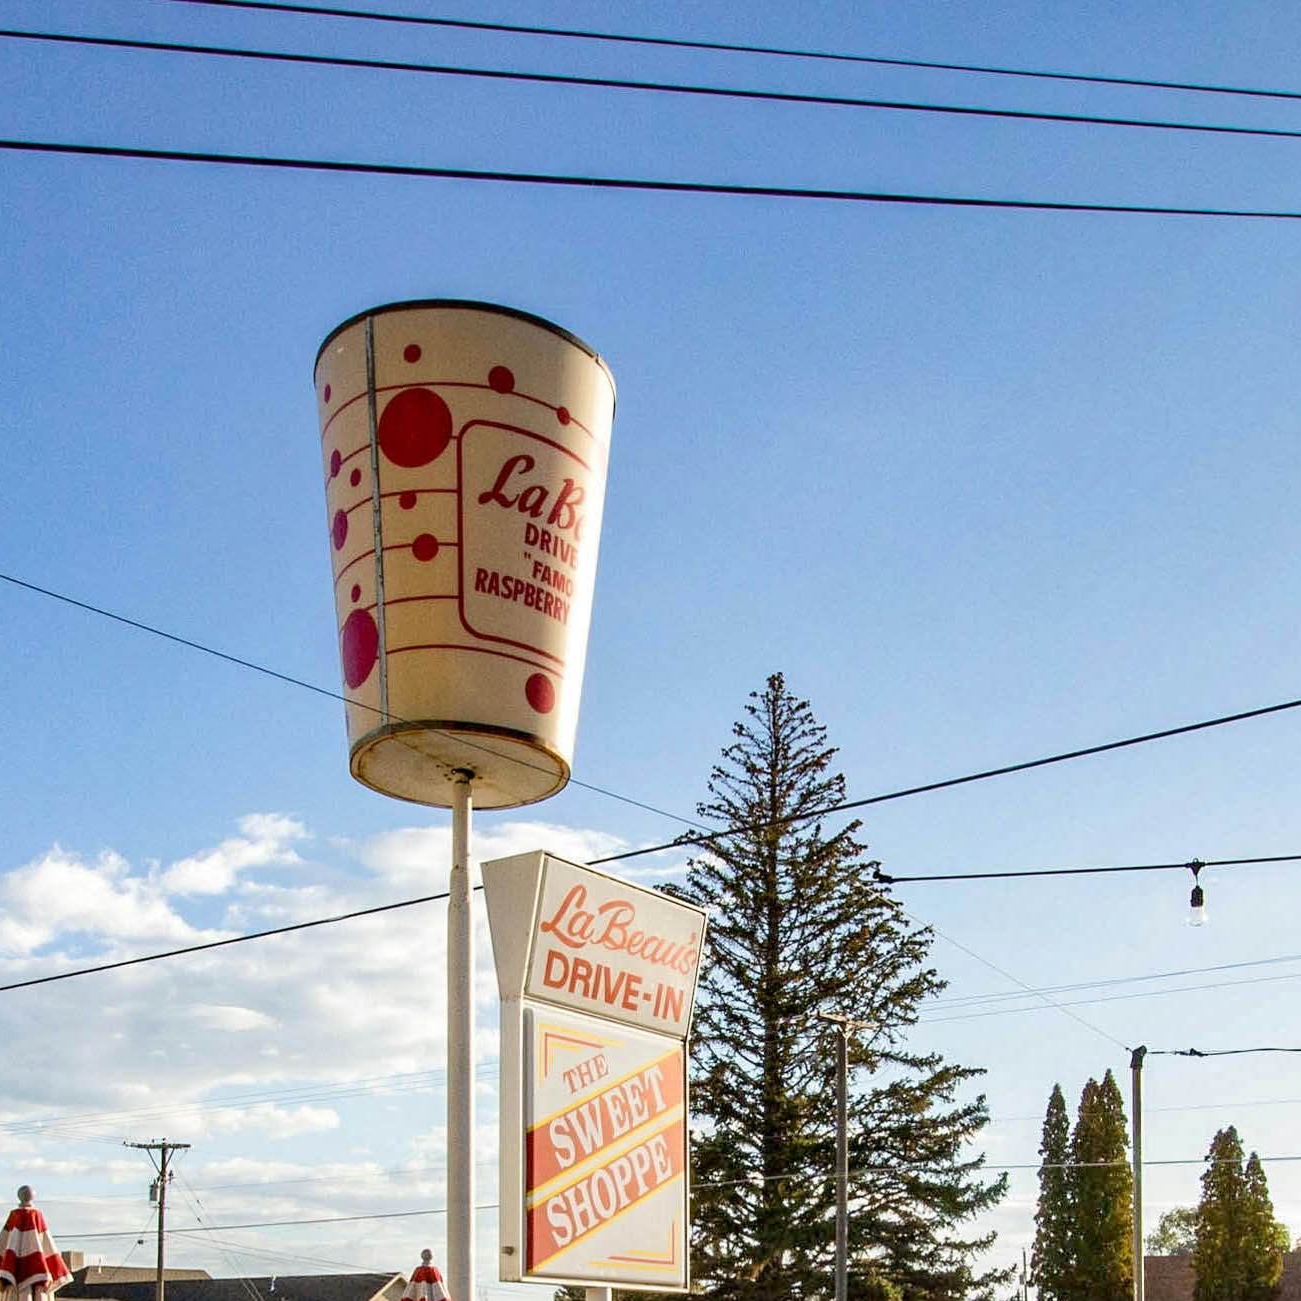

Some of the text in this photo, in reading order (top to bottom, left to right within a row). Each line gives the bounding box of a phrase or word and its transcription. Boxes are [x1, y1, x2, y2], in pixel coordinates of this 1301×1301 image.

[474, 568, 571, 626] RASPBERRY
[542, 948, 685, 1024] DRIVE-IN
[562, 1053, 610, 1095] THE
[549, 1065, 668, 1169] SWEET
[546, 1133, 673, 1248] SHOPPE
